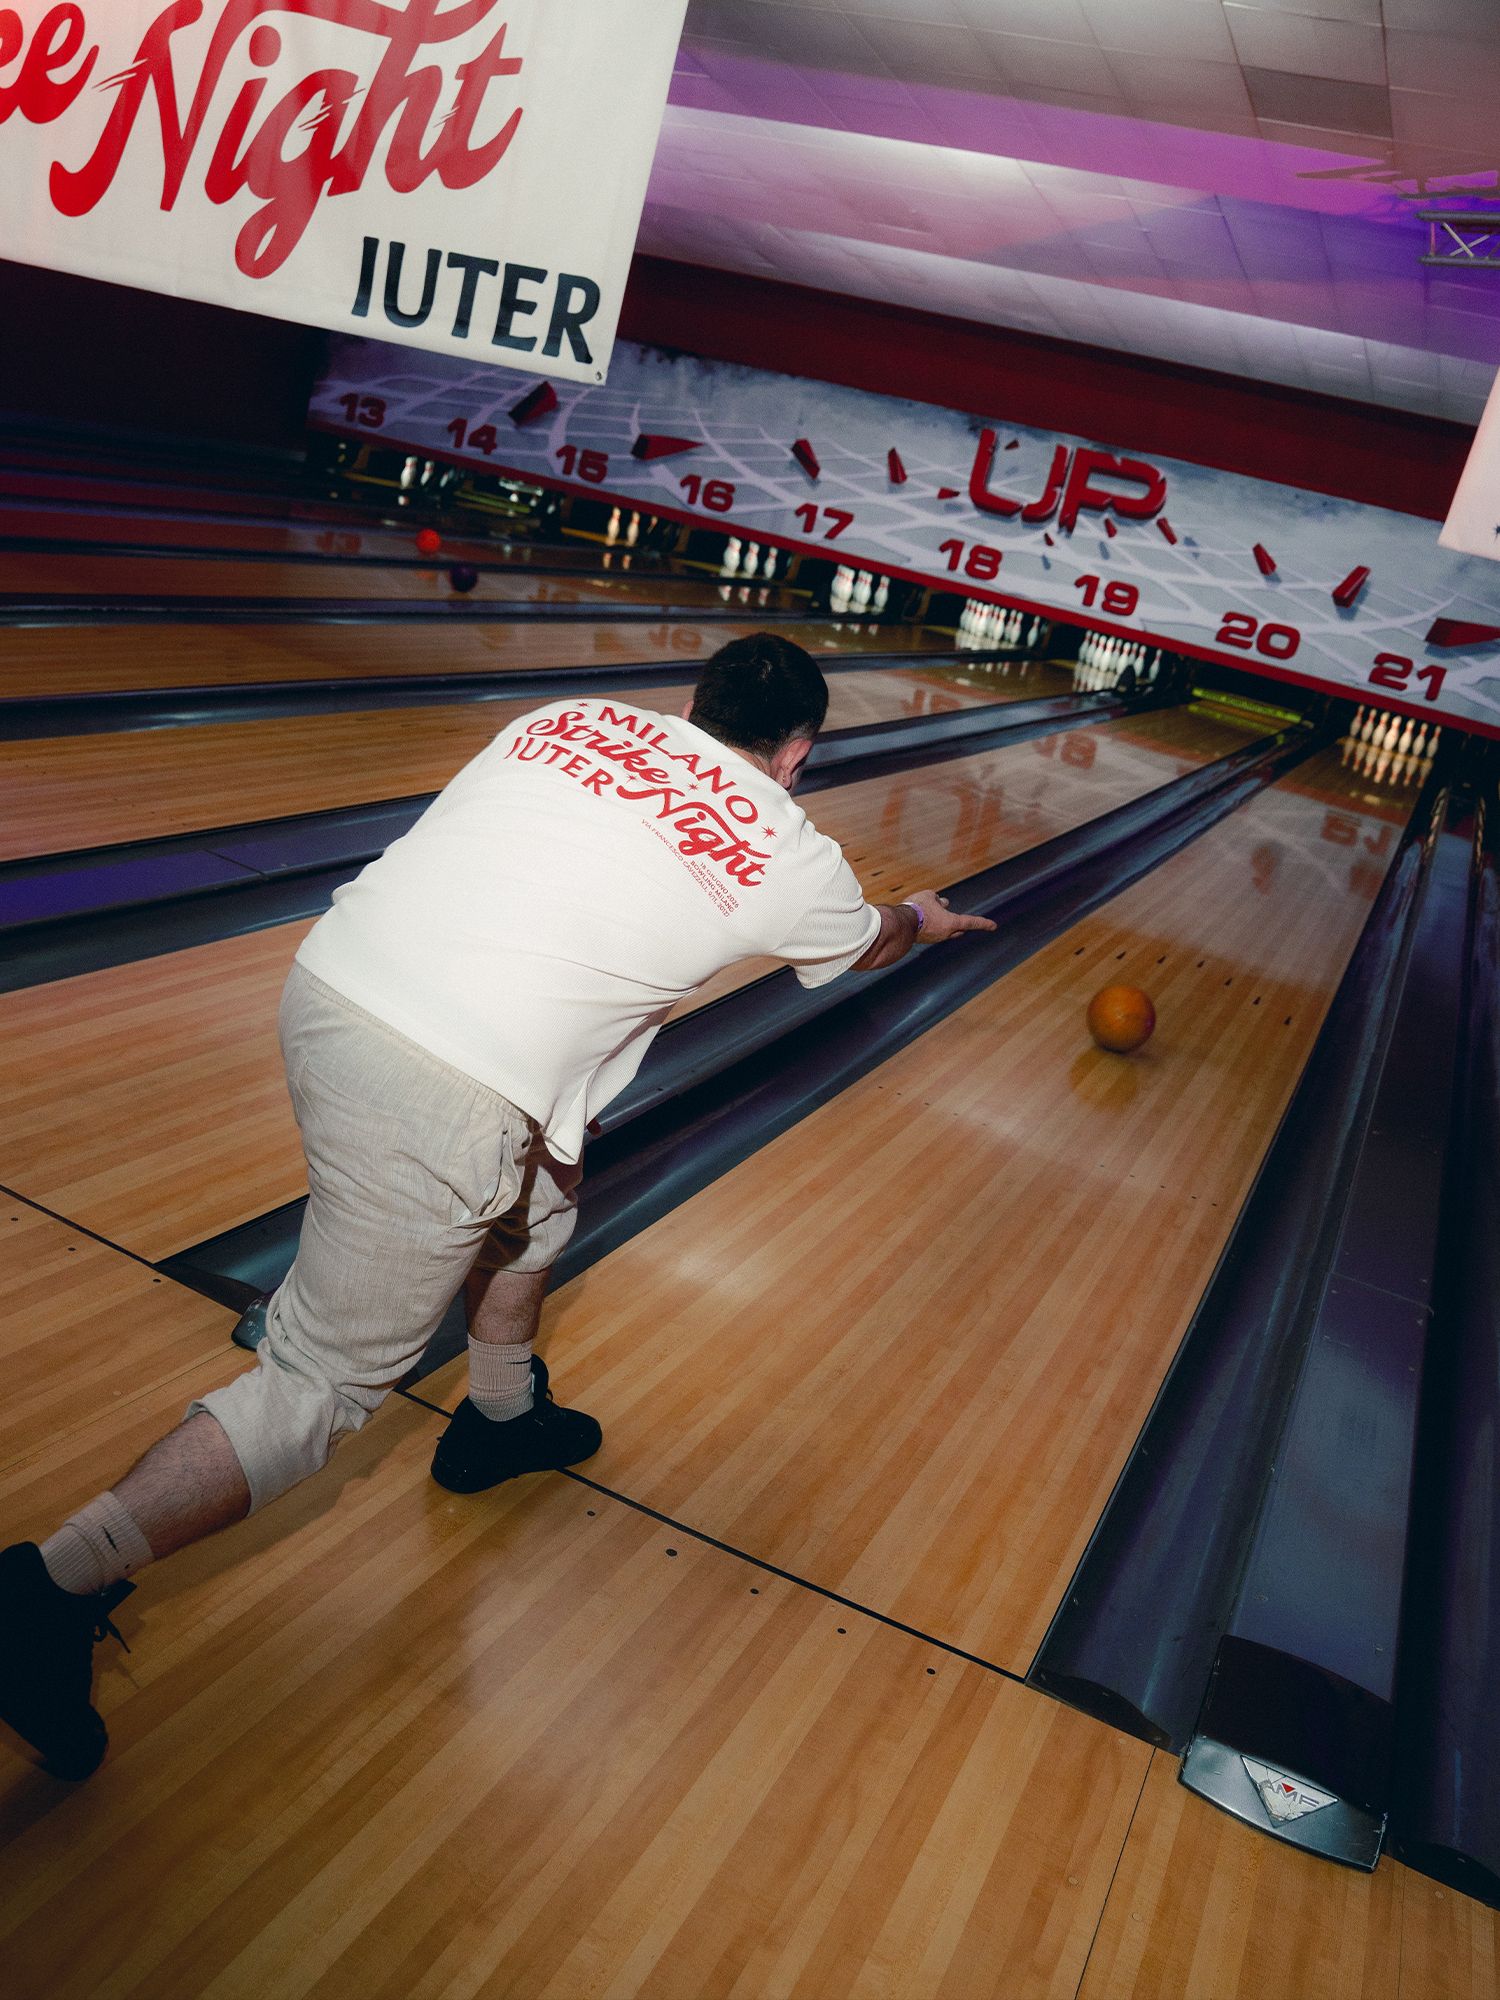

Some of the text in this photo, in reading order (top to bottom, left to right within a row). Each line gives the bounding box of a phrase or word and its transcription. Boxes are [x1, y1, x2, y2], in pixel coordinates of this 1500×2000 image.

[50, 0, 524, 279] Night
[351, 236, 601, 364] IUTER
[338, 392, 386, 429] 13
[447, 418, 498, 456] 14
[556, 445, 609, 483] 15
[968, 428, 1167, 534] UP
[679, 474, 736, 512] 16
[795, 503, 855, 540] 17
[939, 538, 1002, 580] 18
[1074, 574, 1140, 617] 19
[1215, 611, 1301, 660] 20
[1368, 652, 1448, 701] 21
[504, 736, 614, 797] IUTER
[598, 706, 759, 825] MILANO
[526, 711, 772, 887] Strike Night
[690, 860, 735, 913] BOWLING MILANO
